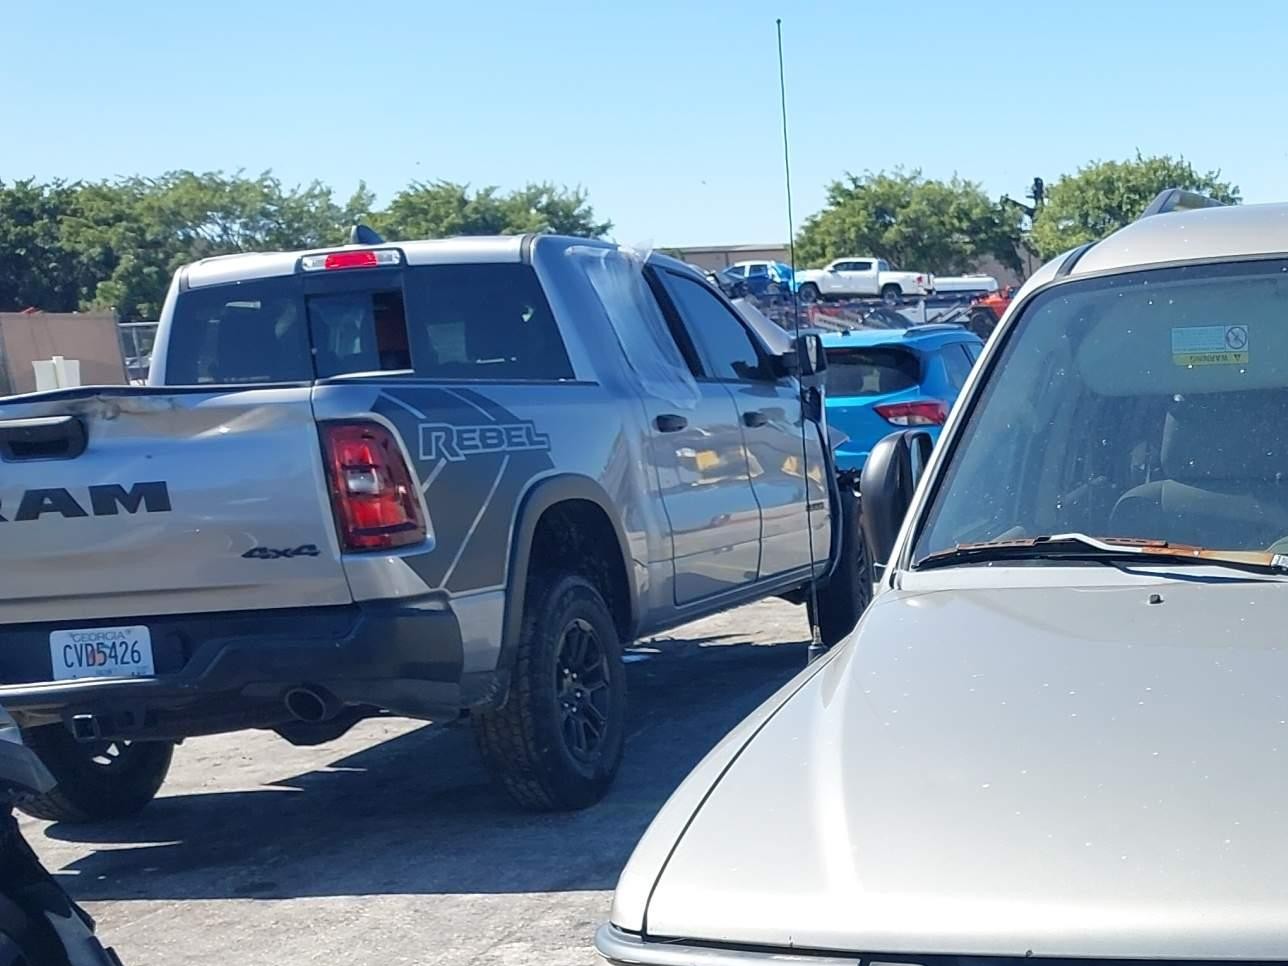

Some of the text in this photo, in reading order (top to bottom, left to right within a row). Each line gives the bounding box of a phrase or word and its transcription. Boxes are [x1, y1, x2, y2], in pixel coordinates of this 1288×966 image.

[418, 420, 549, 462] REBEL
[0, 481, 172, 522] AM
[241, 544, 321, 560] 4x4
[72, 631, 126, 643] GEORGIA
[63, 640, 142, 668] CVD5426
